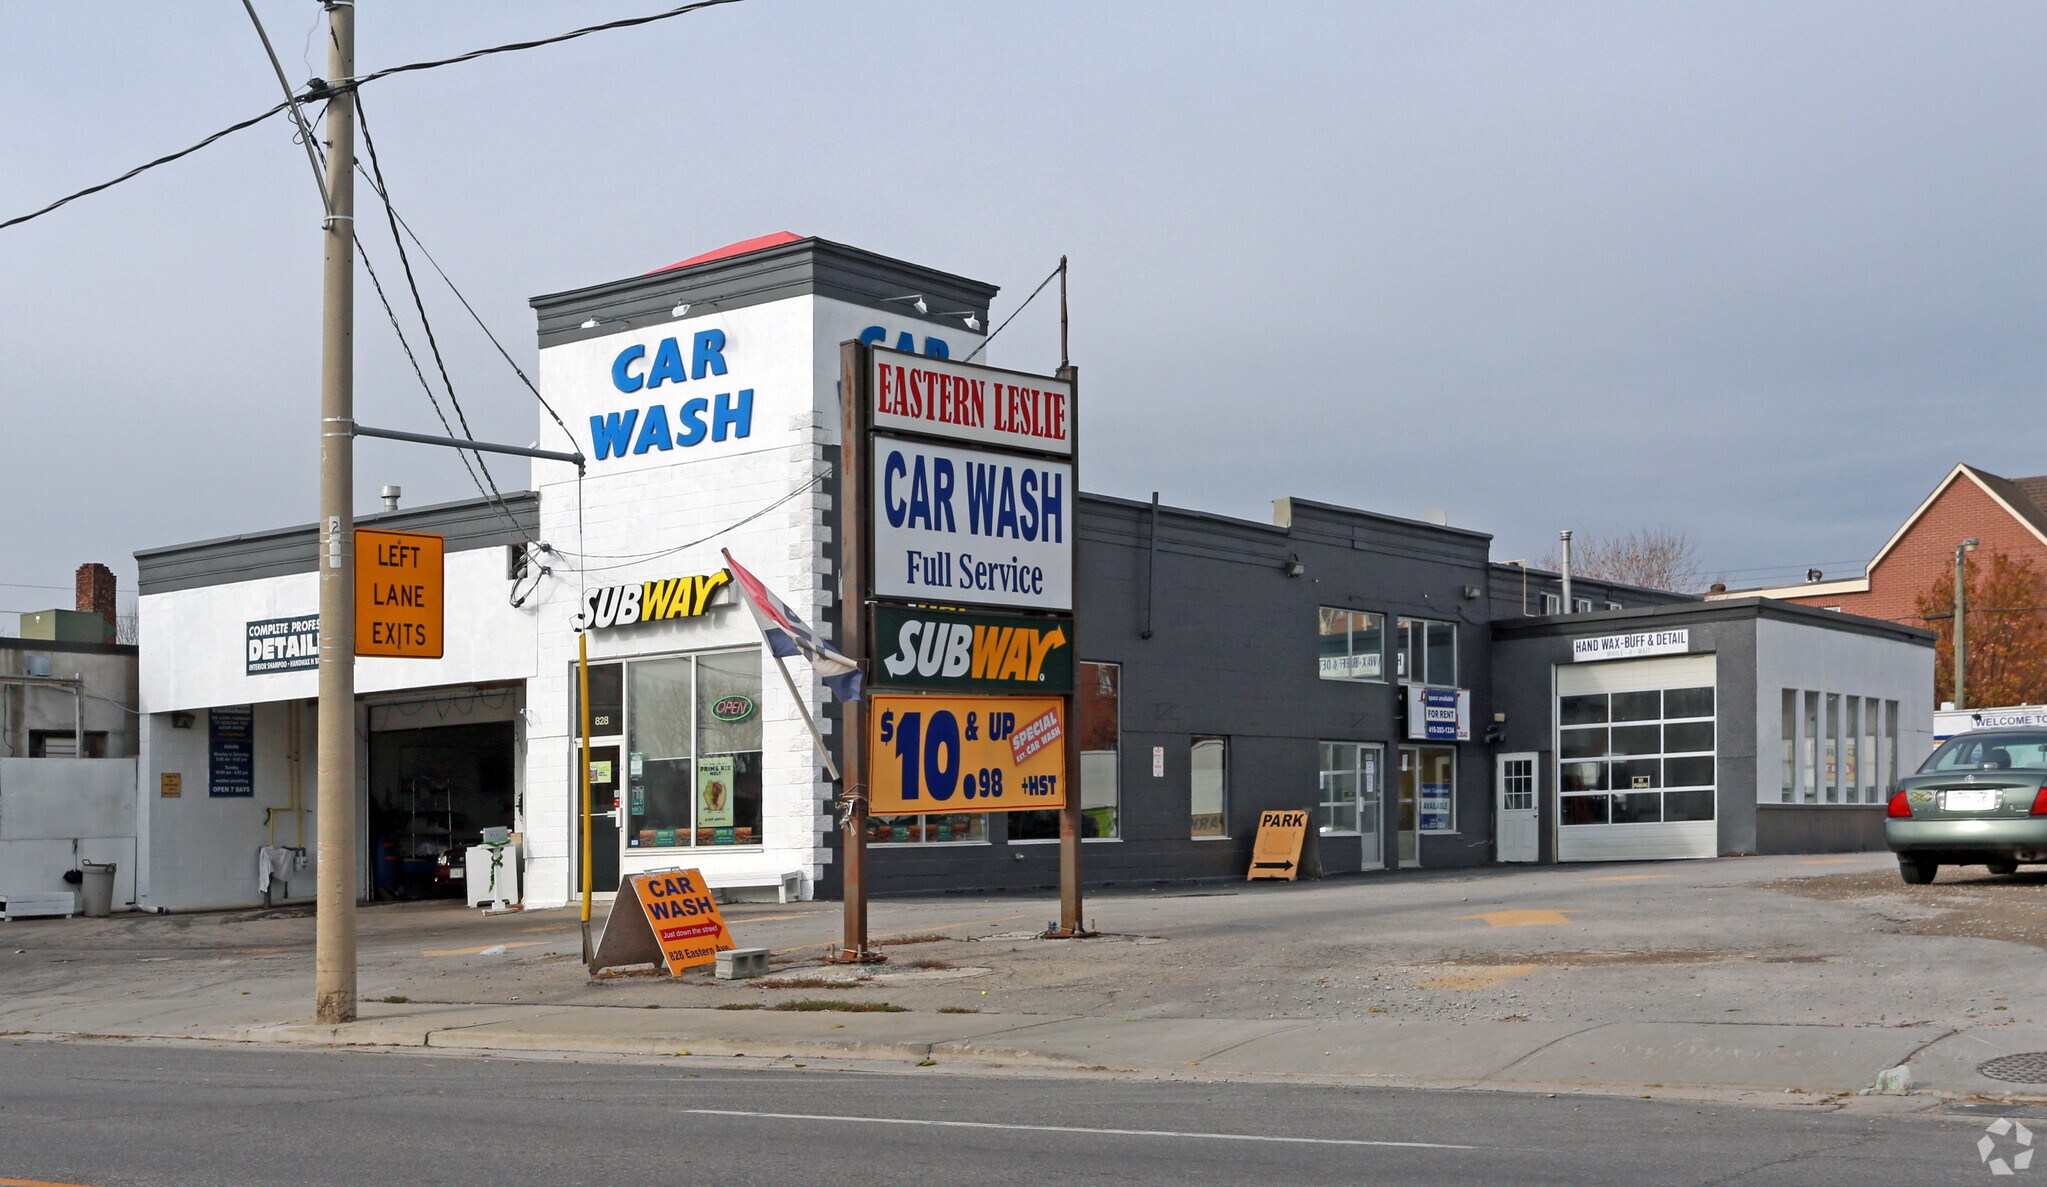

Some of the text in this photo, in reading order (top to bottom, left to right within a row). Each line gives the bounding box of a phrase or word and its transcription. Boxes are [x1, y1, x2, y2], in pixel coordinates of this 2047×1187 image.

[611, 328, 728, 394] CAR
[878, 362, 1066, 440] EASTERN LESLIE
[589, 388, 754, 461] WASH
[884, 450, 1063, 544] CAR WASH
[378, 544, 421, 568] LEFT
[906, 549, 1043, 595] Full Service
[373, 583, 425, 607] LANE
[570, 568, 732, 632] SUBWAY
[248, 622, 289, 637] COMPLETE
[372, 622, 426, 646] EXITS
[883, 619, 1066, 682] SUBWAY
[1575, 631, 1686, 653] HAND WAX-BUFF & DETAIL
[267, 661, 287, 670] SHAMPOO
[716, 701, 747, 714] OPEN
[1428, 709, 1454, 720] FOR RENT
[594, 715, 609, 726] 828
[964, 711, 979, 741] &
[989, 712, 1015, 742] UP
[1012, 711, 1057, 751] SPECIAL
[1975, 715, 2031, 727] WELCOME
[1016, 726, 1061, 762] EXT. CAR WASH
[1022, 774, 1057, 796] +HST
[1423, 801, 1448, 810] AVAILABLE
[1262, 813, 1305, 828] PARK
[648, 876, 696, 898] CAR
[646, 896, 714, 921] WASH
[663, 925, 718, 939] Just down the street
[668, 949, 685, 961] 828
[685, 945, 715, 959] Eastern
